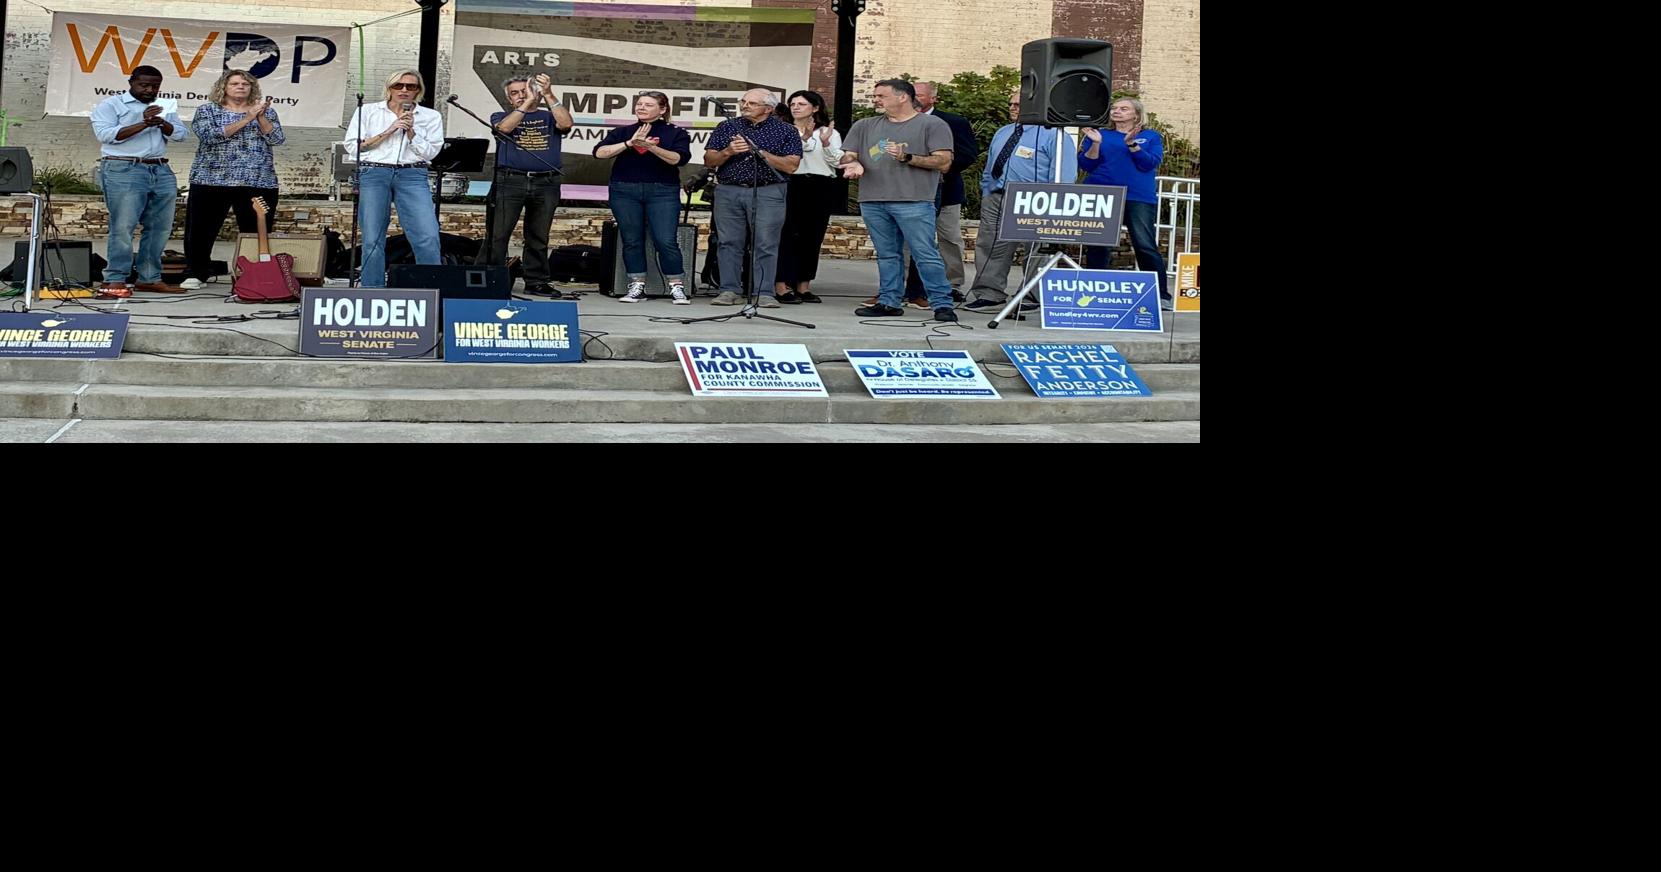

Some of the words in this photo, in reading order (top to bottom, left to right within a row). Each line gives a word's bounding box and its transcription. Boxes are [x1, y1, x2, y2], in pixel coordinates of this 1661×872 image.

[66, 23, 337, 84] WVDP
[480, 50, 561, 67] ARTS
[94, 87, 126, 96] West
[265, 96, 299, 106] Party
[1013, 191, 1114, 218] HOLDEN
[1016, 218, 1050, 226] WEST
[1052, 219, 1105, 228] VIRGINIA
[1036, 227, 1083, 236] SENATE
[1181, 264, 1195, 288] MIKE
[1047, 279, 1146, 294] HUNDLEY
[313, 298, 426, 327] HOLDEN
[1049, 311, 1119, 319] hundley4wv.com
[47, 330, 115, 342] GEORGE
[318, 330, 356, 338] WEST
[359, 330, 420, 339] VIRGINIA
[454, 322, 503, 339] VINCE
[506, 323, 569, 340] GEORGE
[342, 340, 395, 349] SENATE
[455, 338, 471, 347] FOR
[471, 339, 495, 347] WEST
[495, 339, 530, 348] VIRGINIA
[531, 340, 570, 349] WORKERS
[689, 346, 764, 360] PAUL
[1013, 351, 1118, 363] RACHEL
[694, 360, 815, 375] MONROE
[857, 364, 975, 379] DASARO
[900, 360, 954, 369] Anthony
[1023, 364, 1129, 379] FETTY
[1037, 380, 1138, 391] ANDERSON
